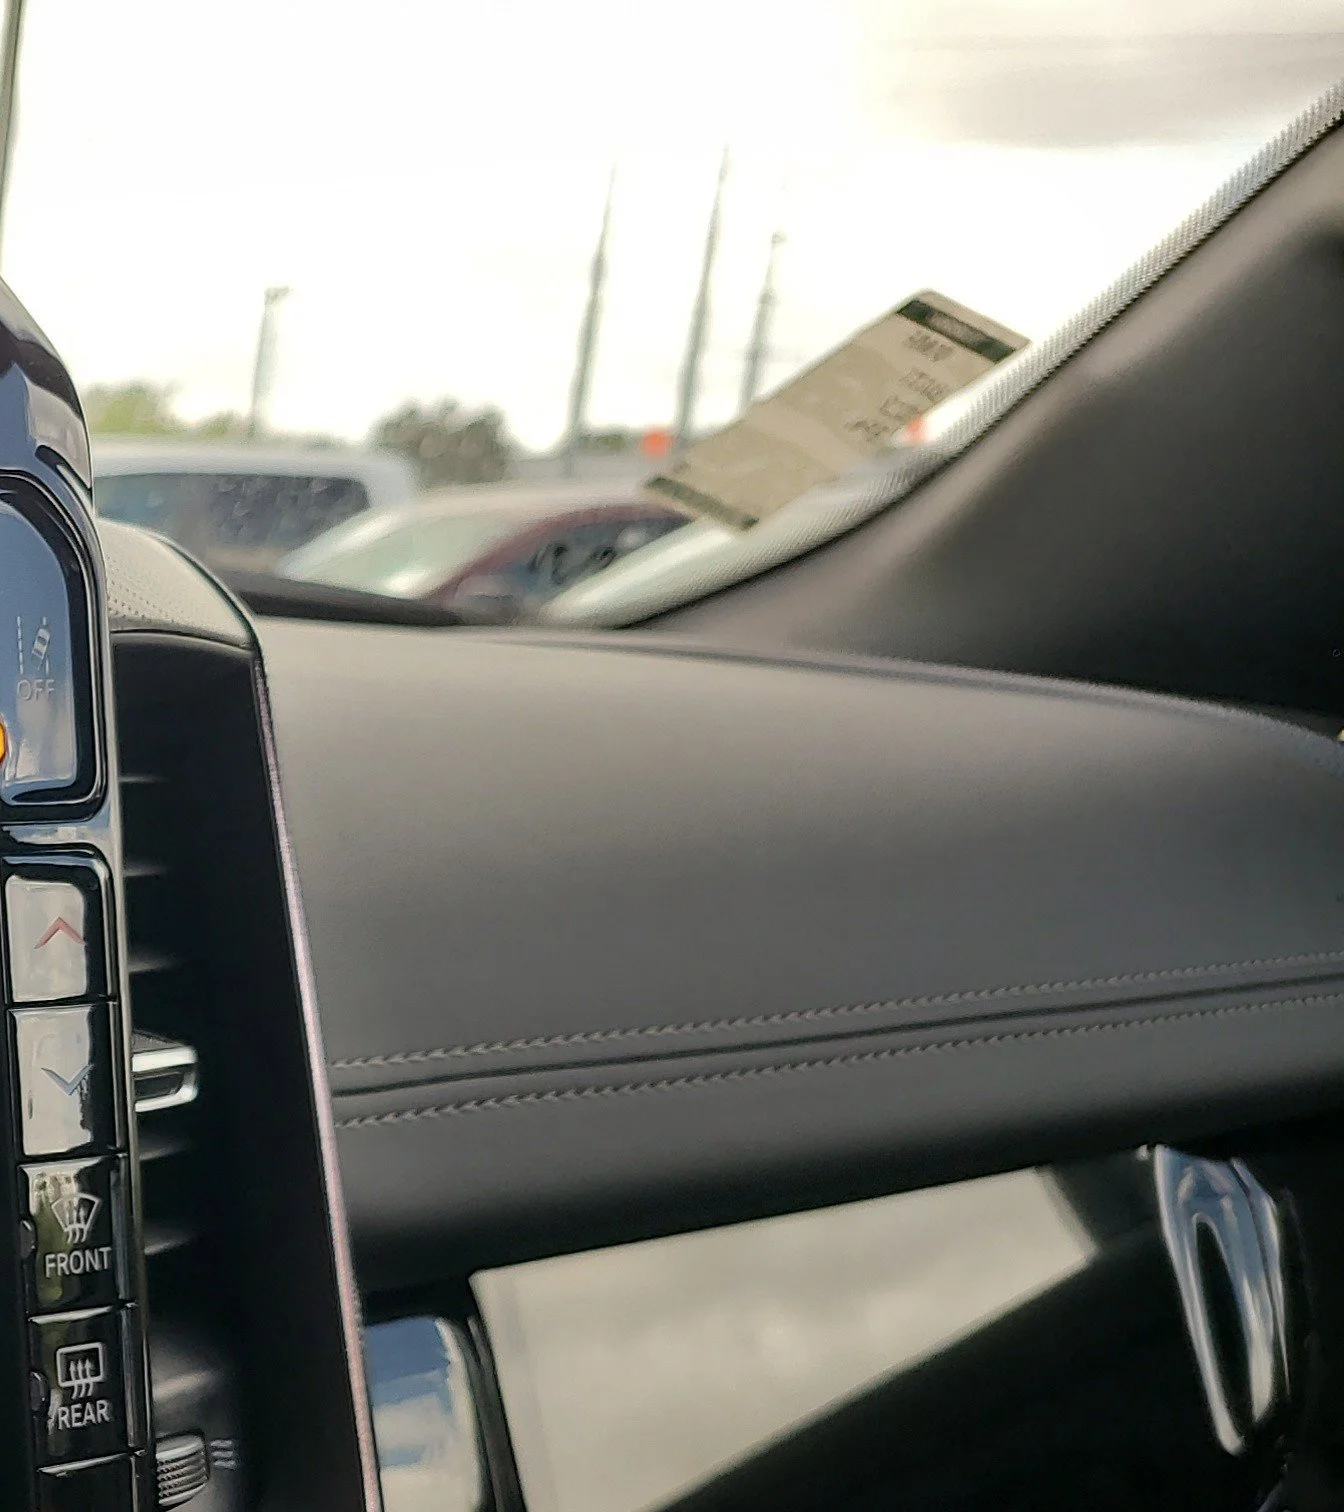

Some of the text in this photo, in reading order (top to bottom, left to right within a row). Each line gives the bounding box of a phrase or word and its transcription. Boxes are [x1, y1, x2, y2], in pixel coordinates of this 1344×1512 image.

[15, 678, 55, 701] OFF
[44, 1246, 112, 1277] FRONT
[57, 1402, 109, 1430] REAR
